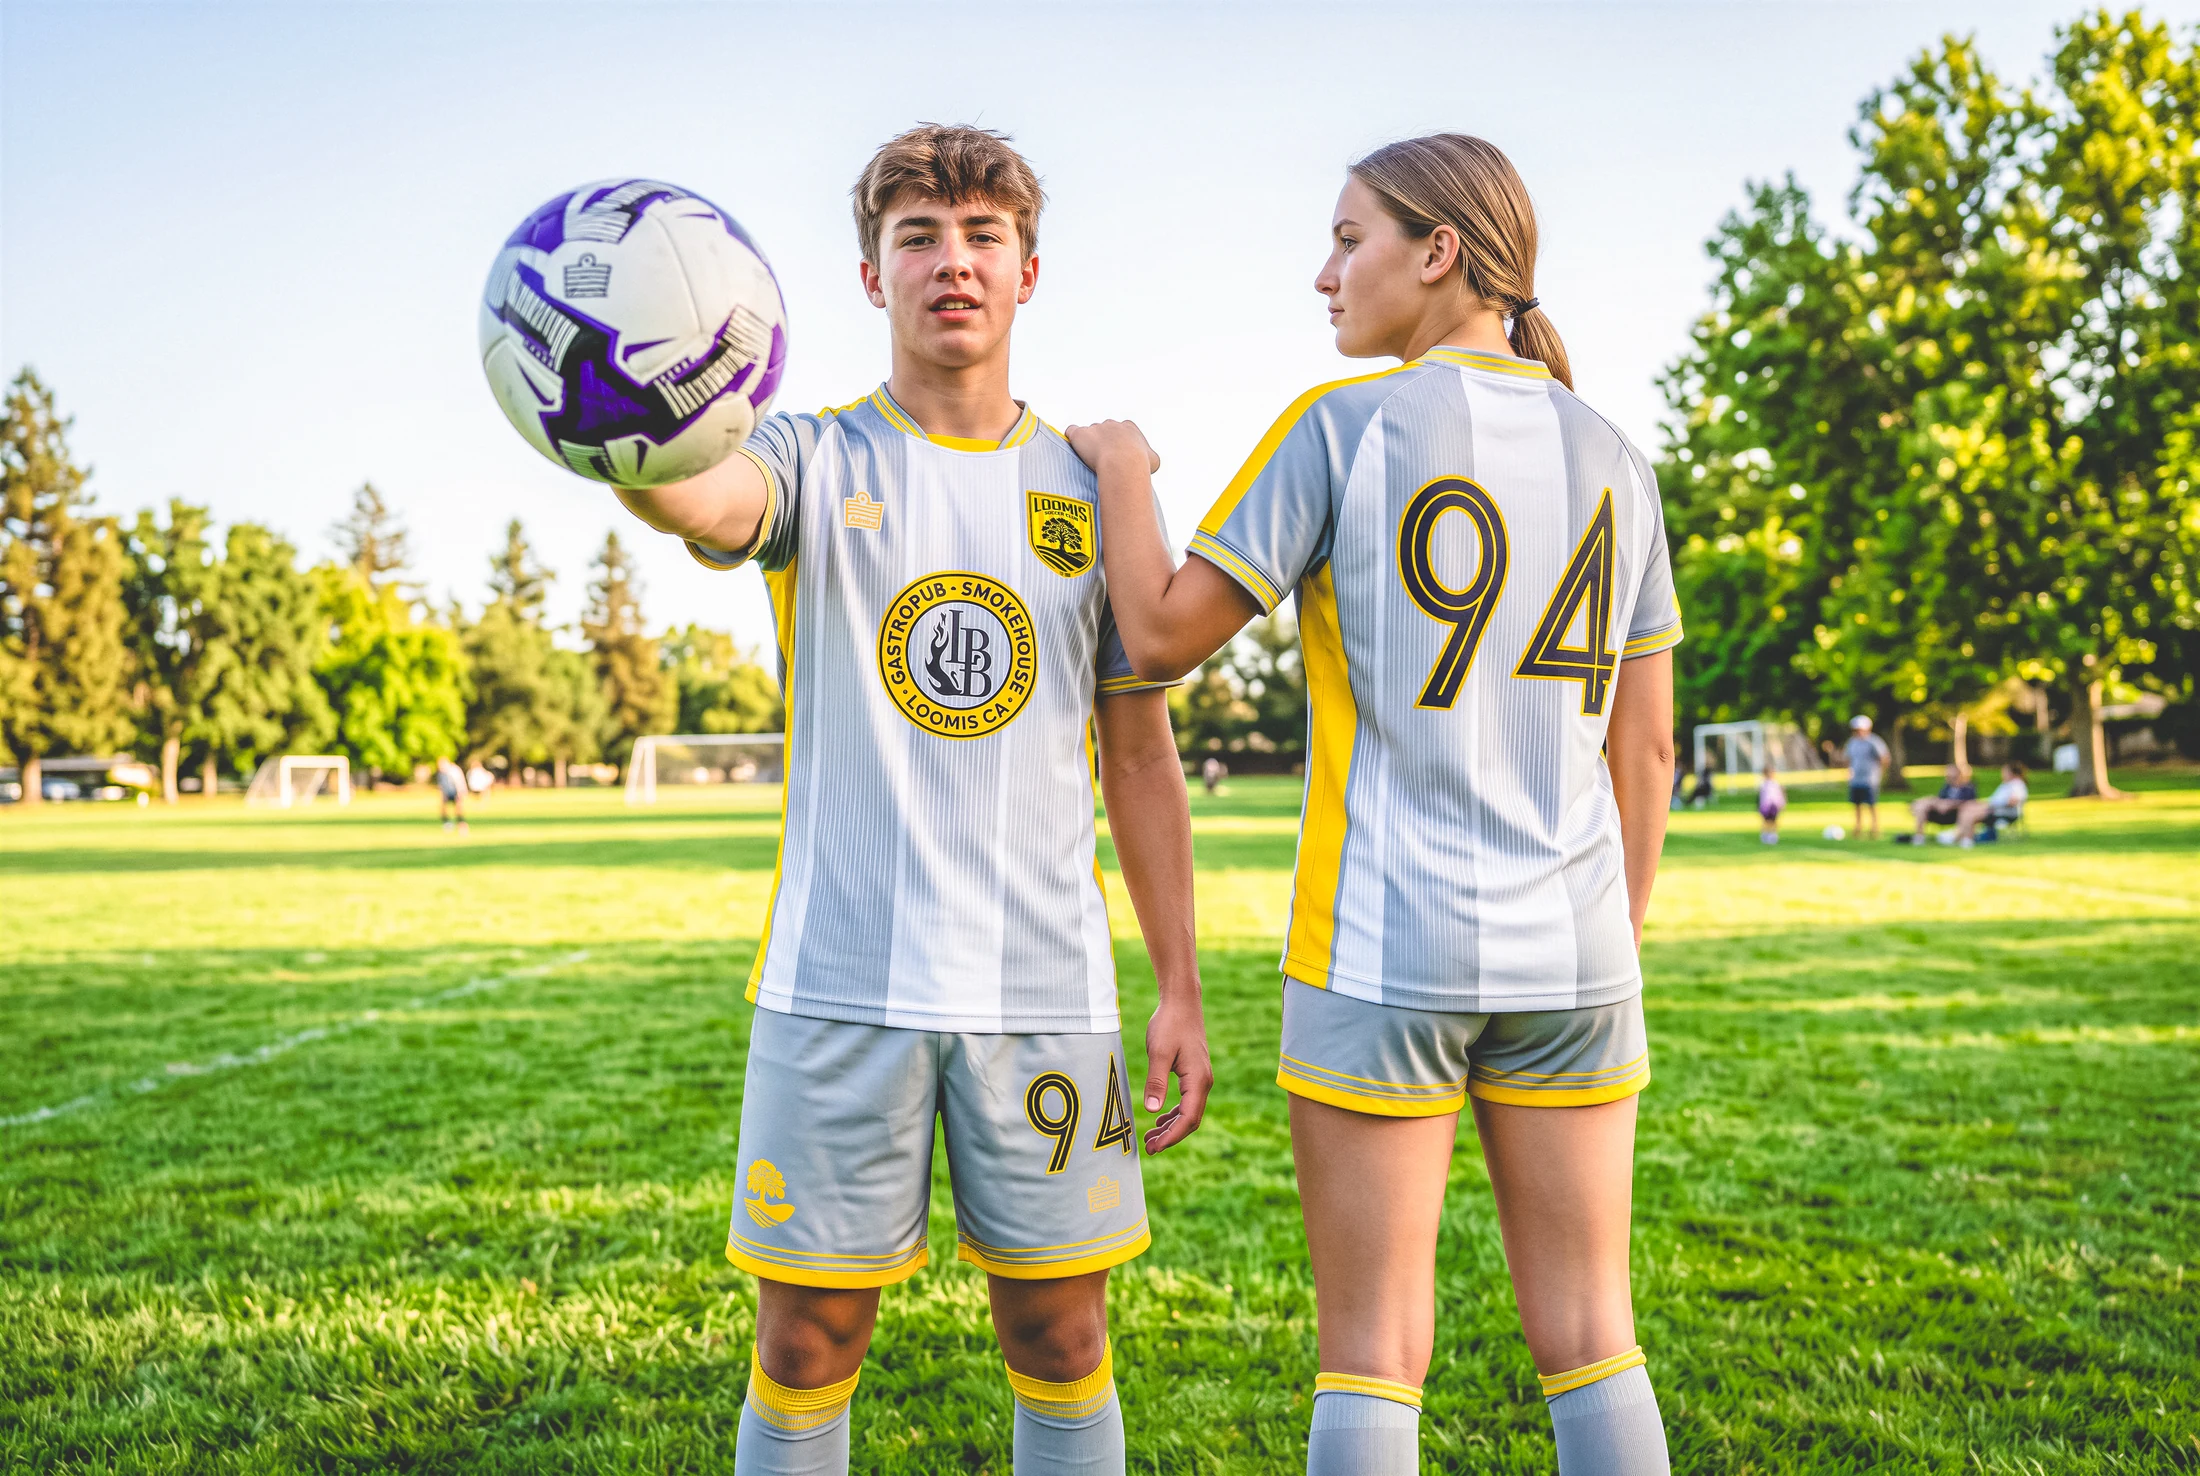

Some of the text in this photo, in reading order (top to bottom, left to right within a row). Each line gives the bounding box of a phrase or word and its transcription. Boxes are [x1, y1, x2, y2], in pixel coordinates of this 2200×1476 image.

[1033, 497, 1088, 523] LOOMIS
[887, 581, 1031, 696] GASTROPUB SMOKEHOUSE
[1396, 474, 1617, 717] 94
[905, 694, 1010, 730] LOOMIS CA
[1023, 1051, 1133, 1176] 94
